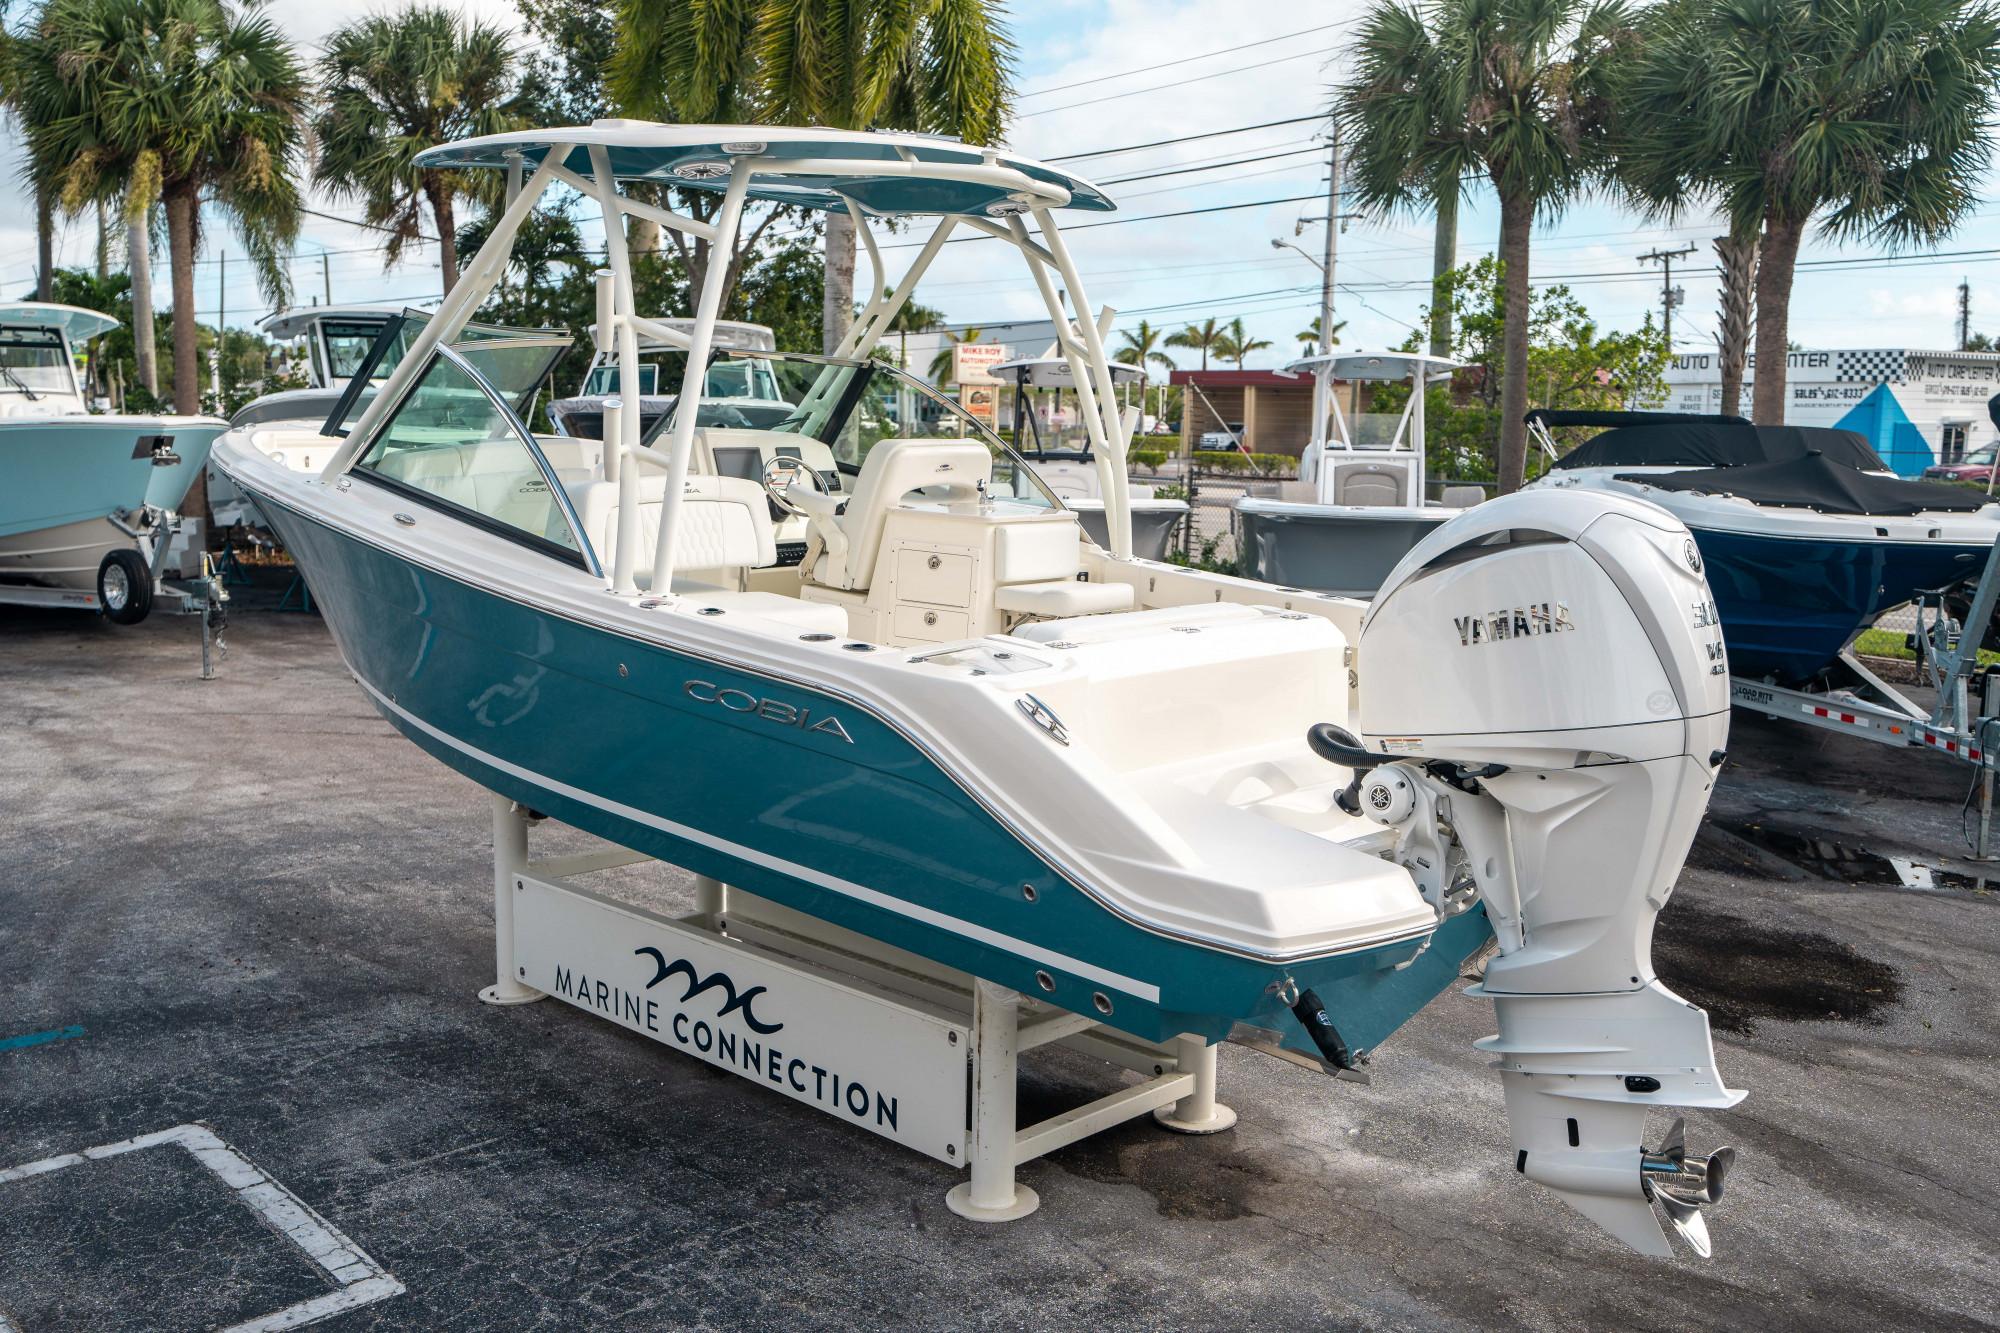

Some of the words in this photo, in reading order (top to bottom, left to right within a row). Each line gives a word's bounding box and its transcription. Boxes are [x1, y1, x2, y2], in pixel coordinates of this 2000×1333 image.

[962, 347, 983, 355] MIKE
[1671, 355, 1710, 370] AUTO
[1927, 363, 1946, 378] AUTO
[1453, 600, 1575, 647] YAMAHA
[1738, 686, 1757, 697] LOAD
[683, 679, 855, 745] COBIA
[555, 963, 659, 1033] MARINE
[672, 1012, 898, 1133] CONNECTION
